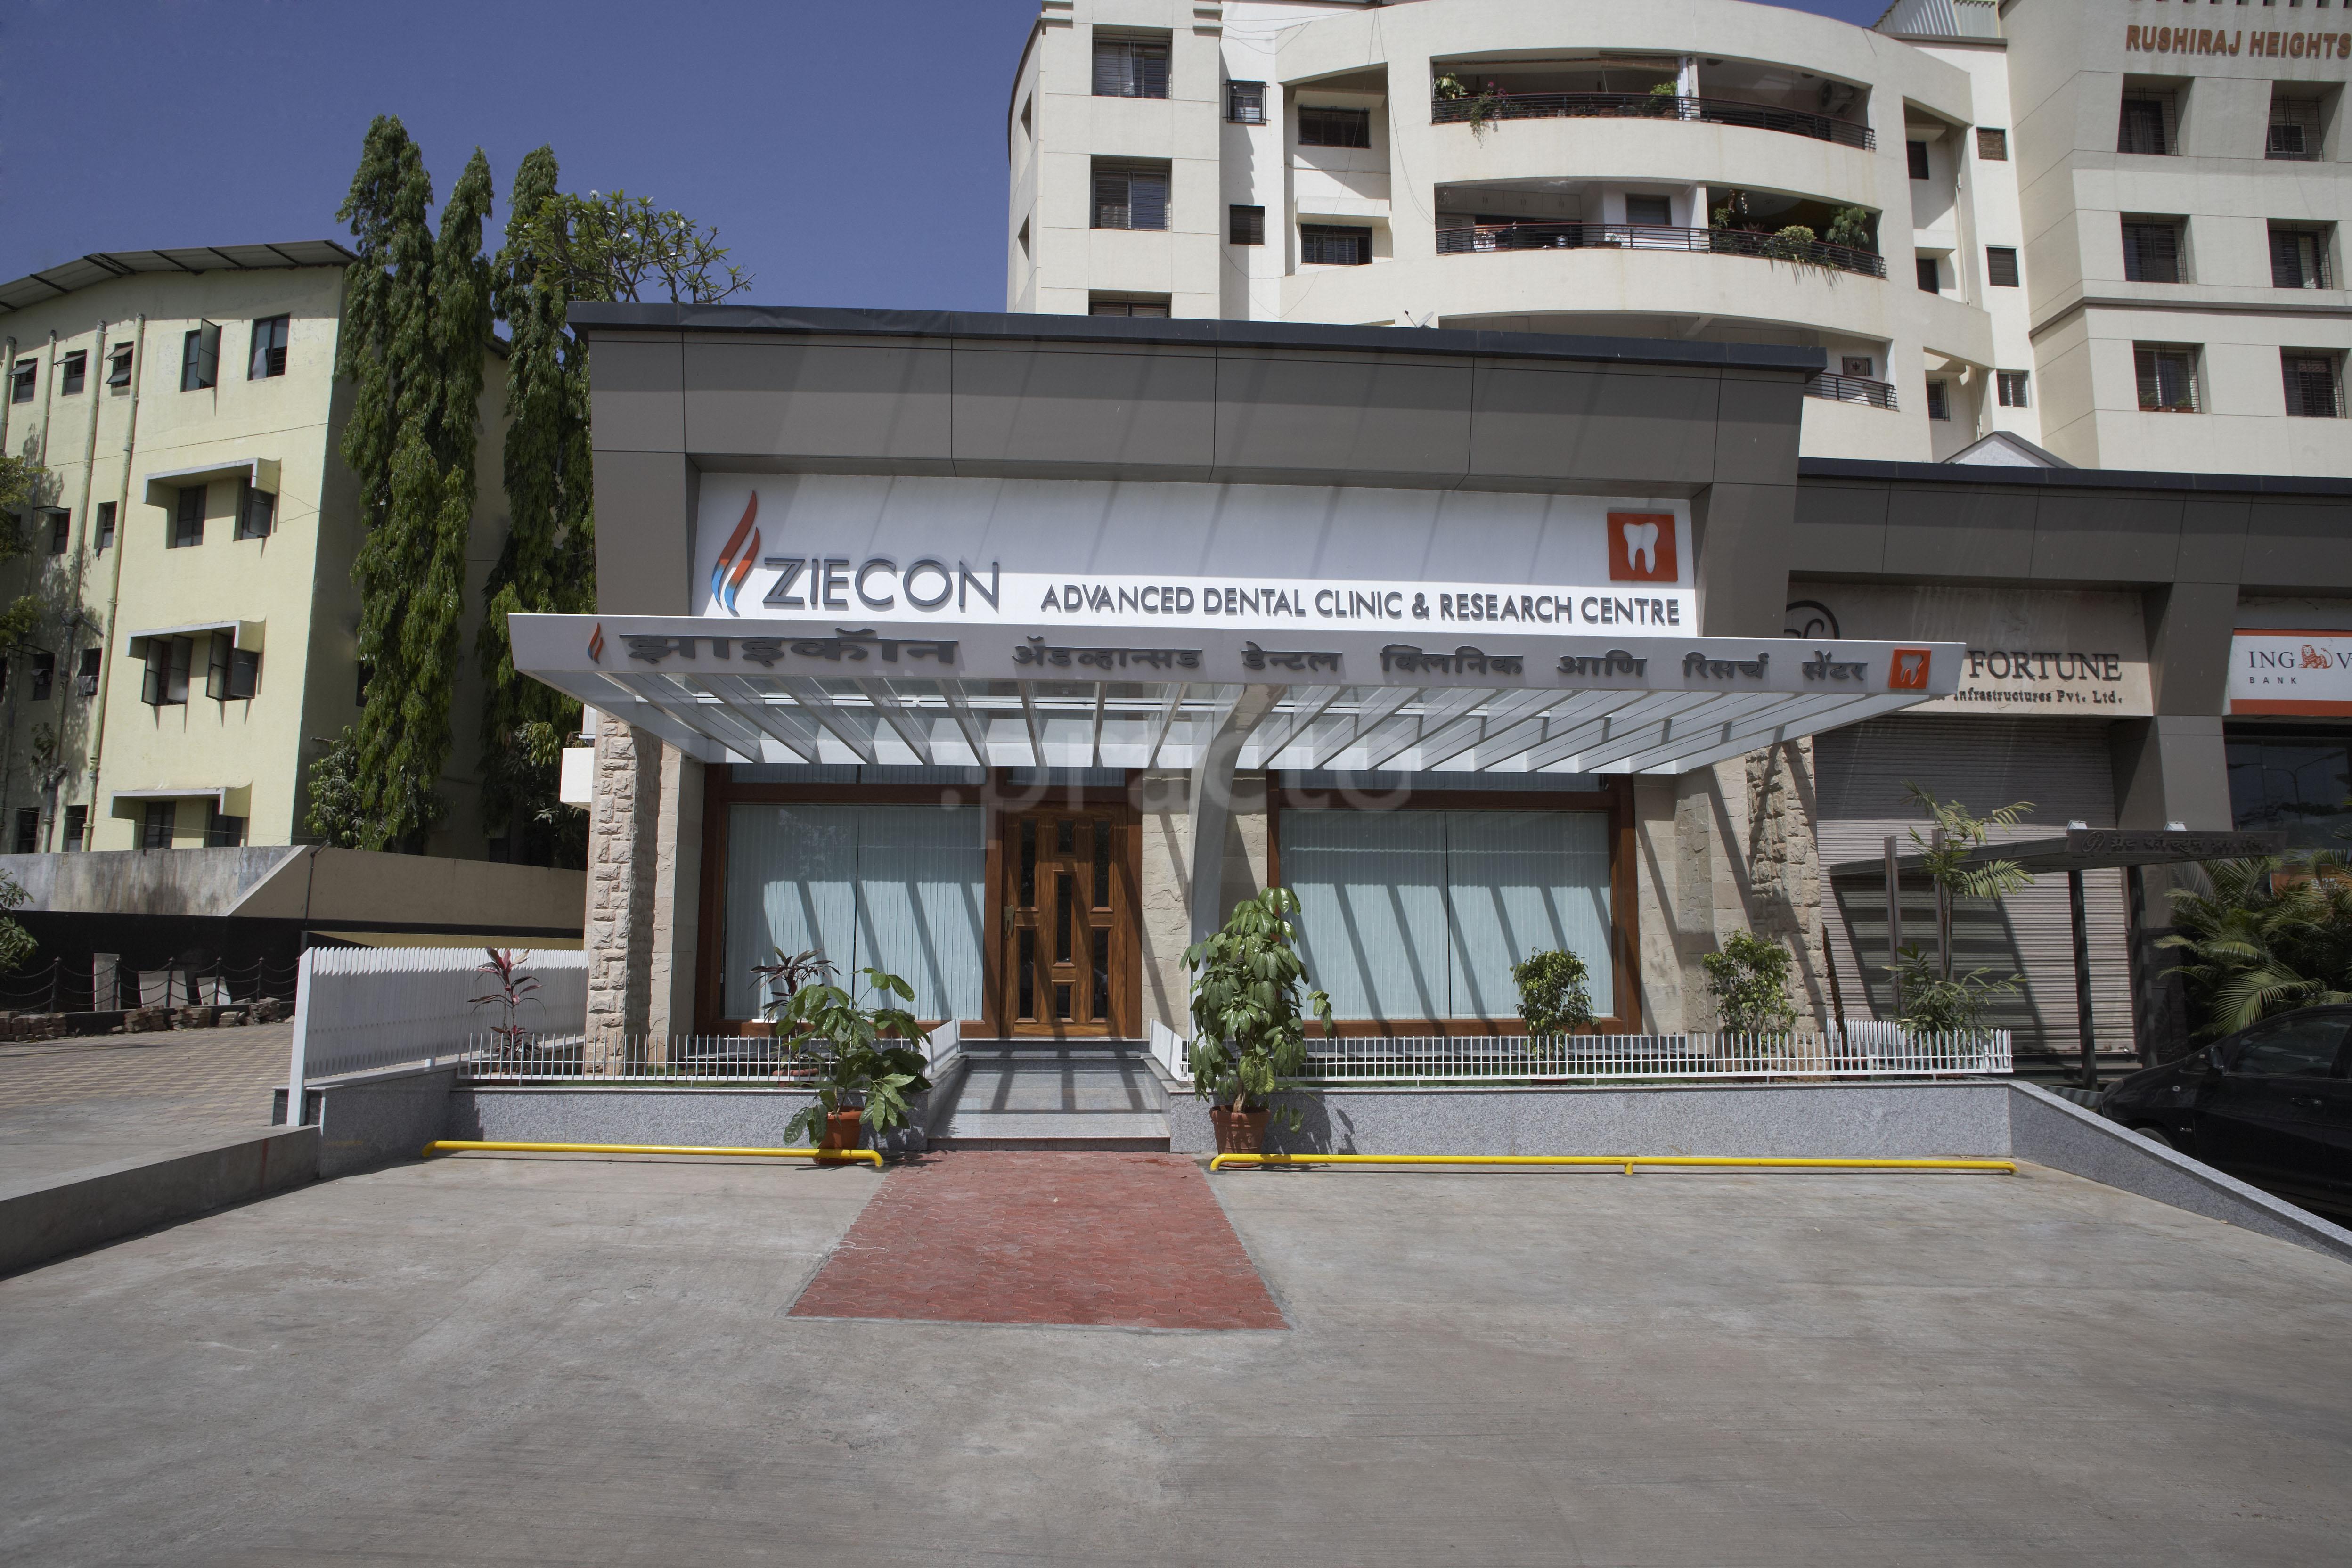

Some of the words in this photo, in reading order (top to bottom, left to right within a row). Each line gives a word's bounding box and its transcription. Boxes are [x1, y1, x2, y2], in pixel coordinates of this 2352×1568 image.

[2126, 25, 2242, 55] RUSHIRAJ
[2249, 31, 2352, 58] HEIGHTS
[761, 557, 1000, 612] ZIECON
[1041, 584, 1194, 612] ADVANCED
[1204, 588, 1306, 614] DENTAL
[1315, 589, 1402, 616] CLINIC
[1412, 592, 1429, 616] &
[1440, 593, 1572, 621] RESEARCH
[1581, 596, 1680, 623] CENTRE
[1241, 640, 1343, 672] डेन्टल
[1380, 643, 1524, 675] क्लिनिक
[1556, 648, 1647, 677] आणि
[1682, 651, 1770, 679] रिसर्च
[1802, 650, 1868, 681] सेंटर
[1968, 650, 2122, 681] FORTUNE
[2248, 651, 2295, 668] ING
[2057, 689, 2086, 703] Pvt.
[2093, 690, 2122, 704] Ltd.
